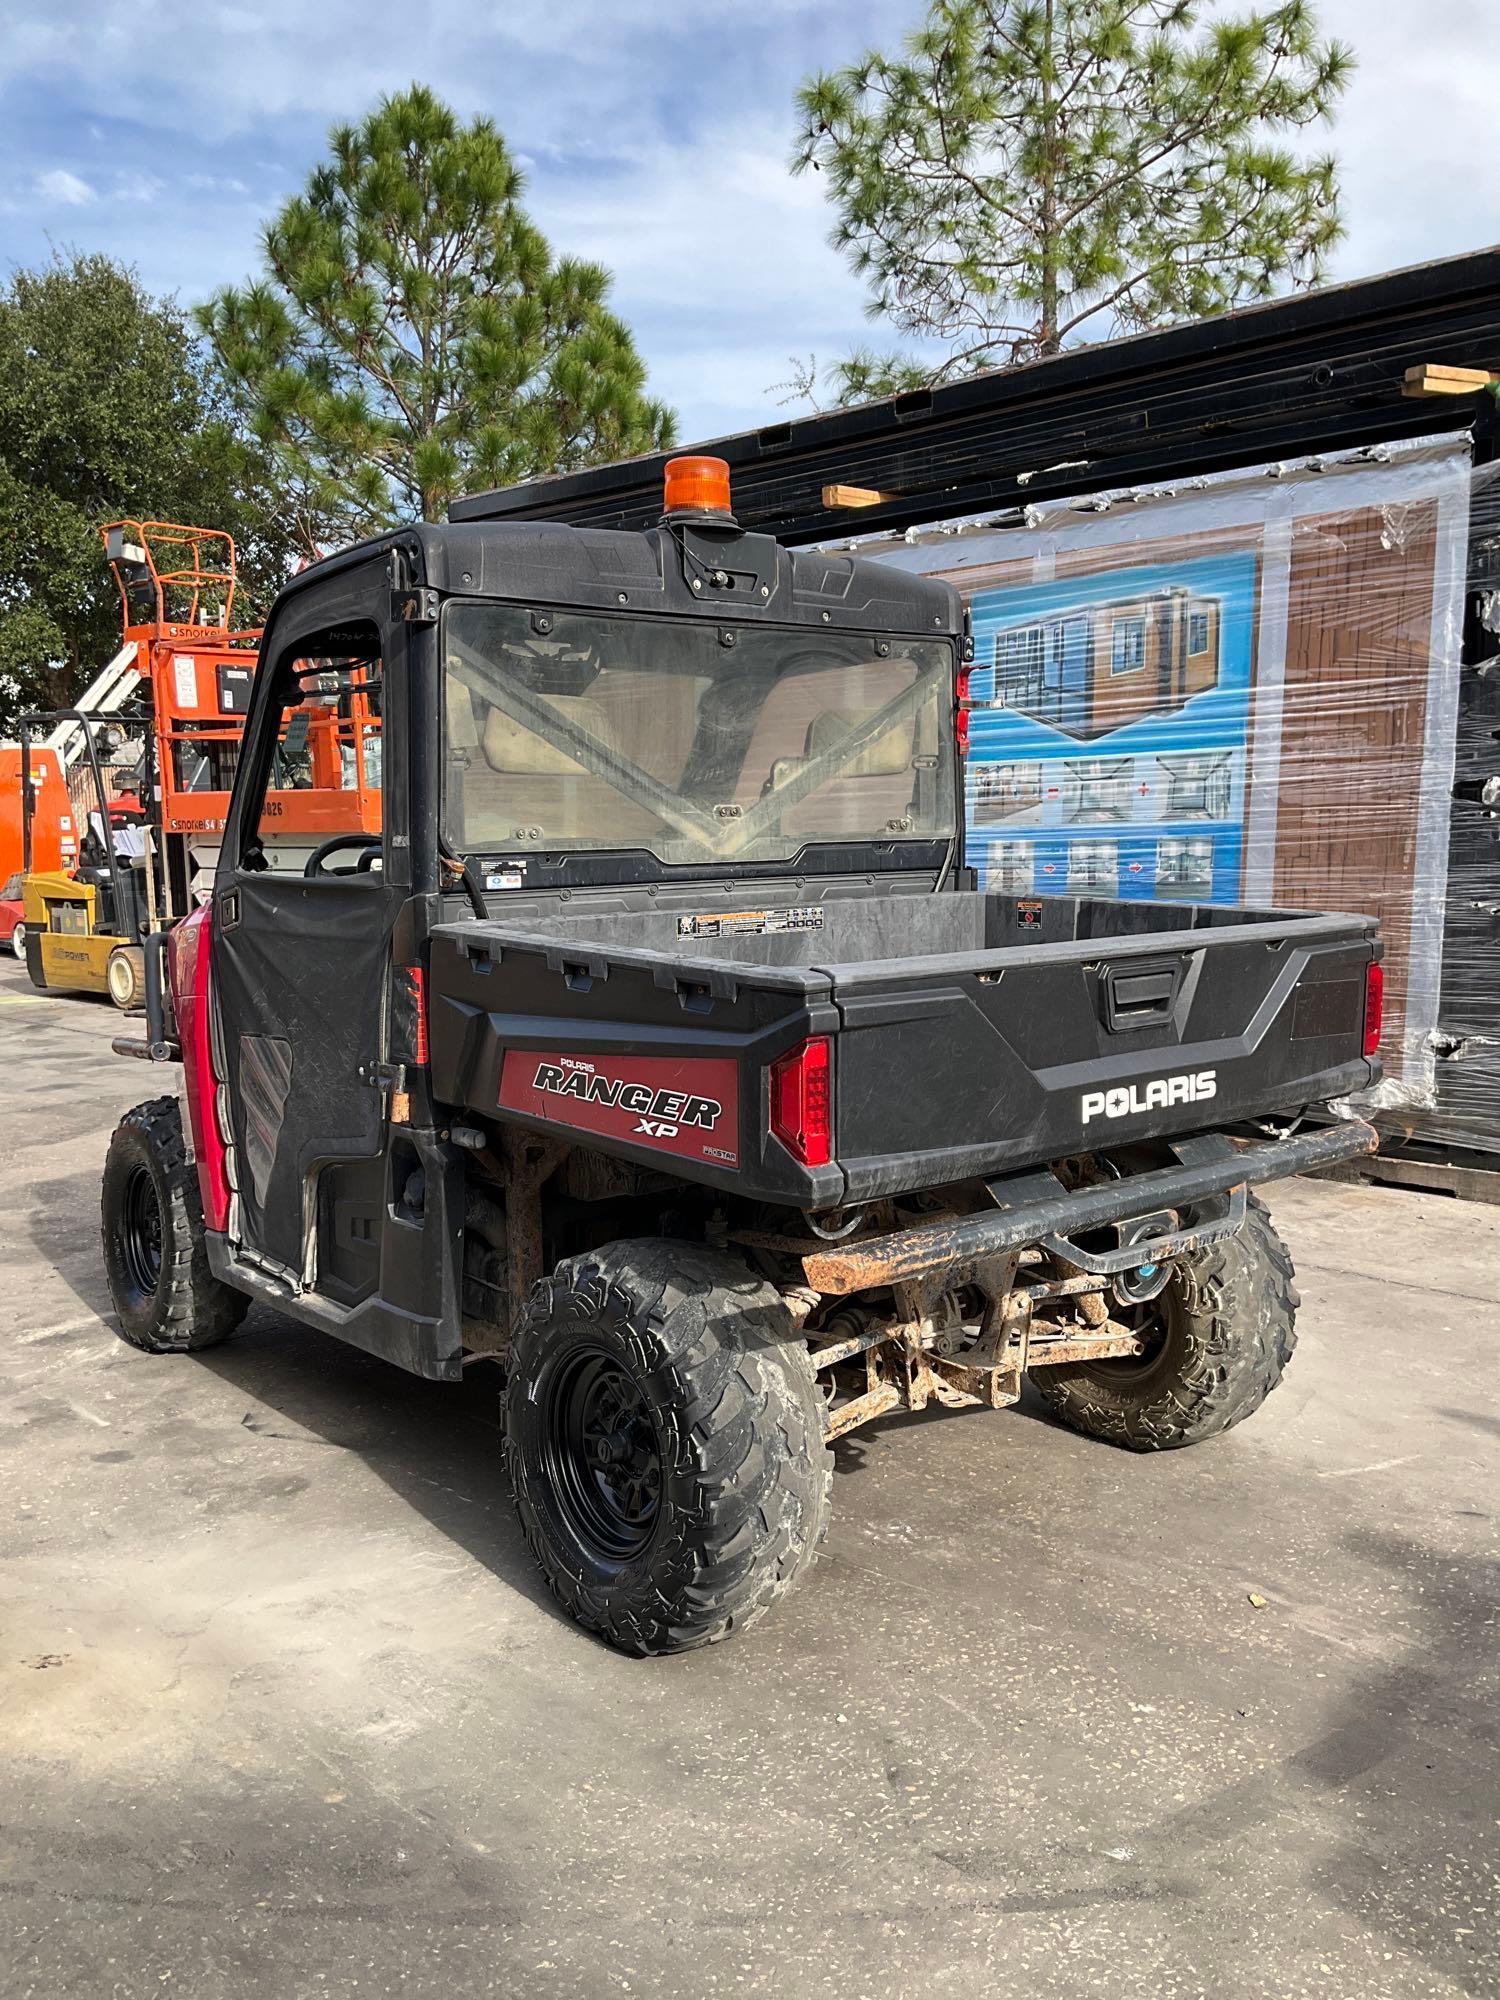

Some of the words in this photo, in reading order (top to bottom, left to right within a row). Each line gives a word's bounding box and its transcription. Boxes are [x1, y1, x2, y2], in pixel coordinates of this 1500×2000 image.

[560, 1057, 595, 1073] POLARIS
[532, 1062, 722, 1130] RANGER
[1081, 1069, 1217, 1124] POLARIS
[632, 1117, 680, 1139] XP
